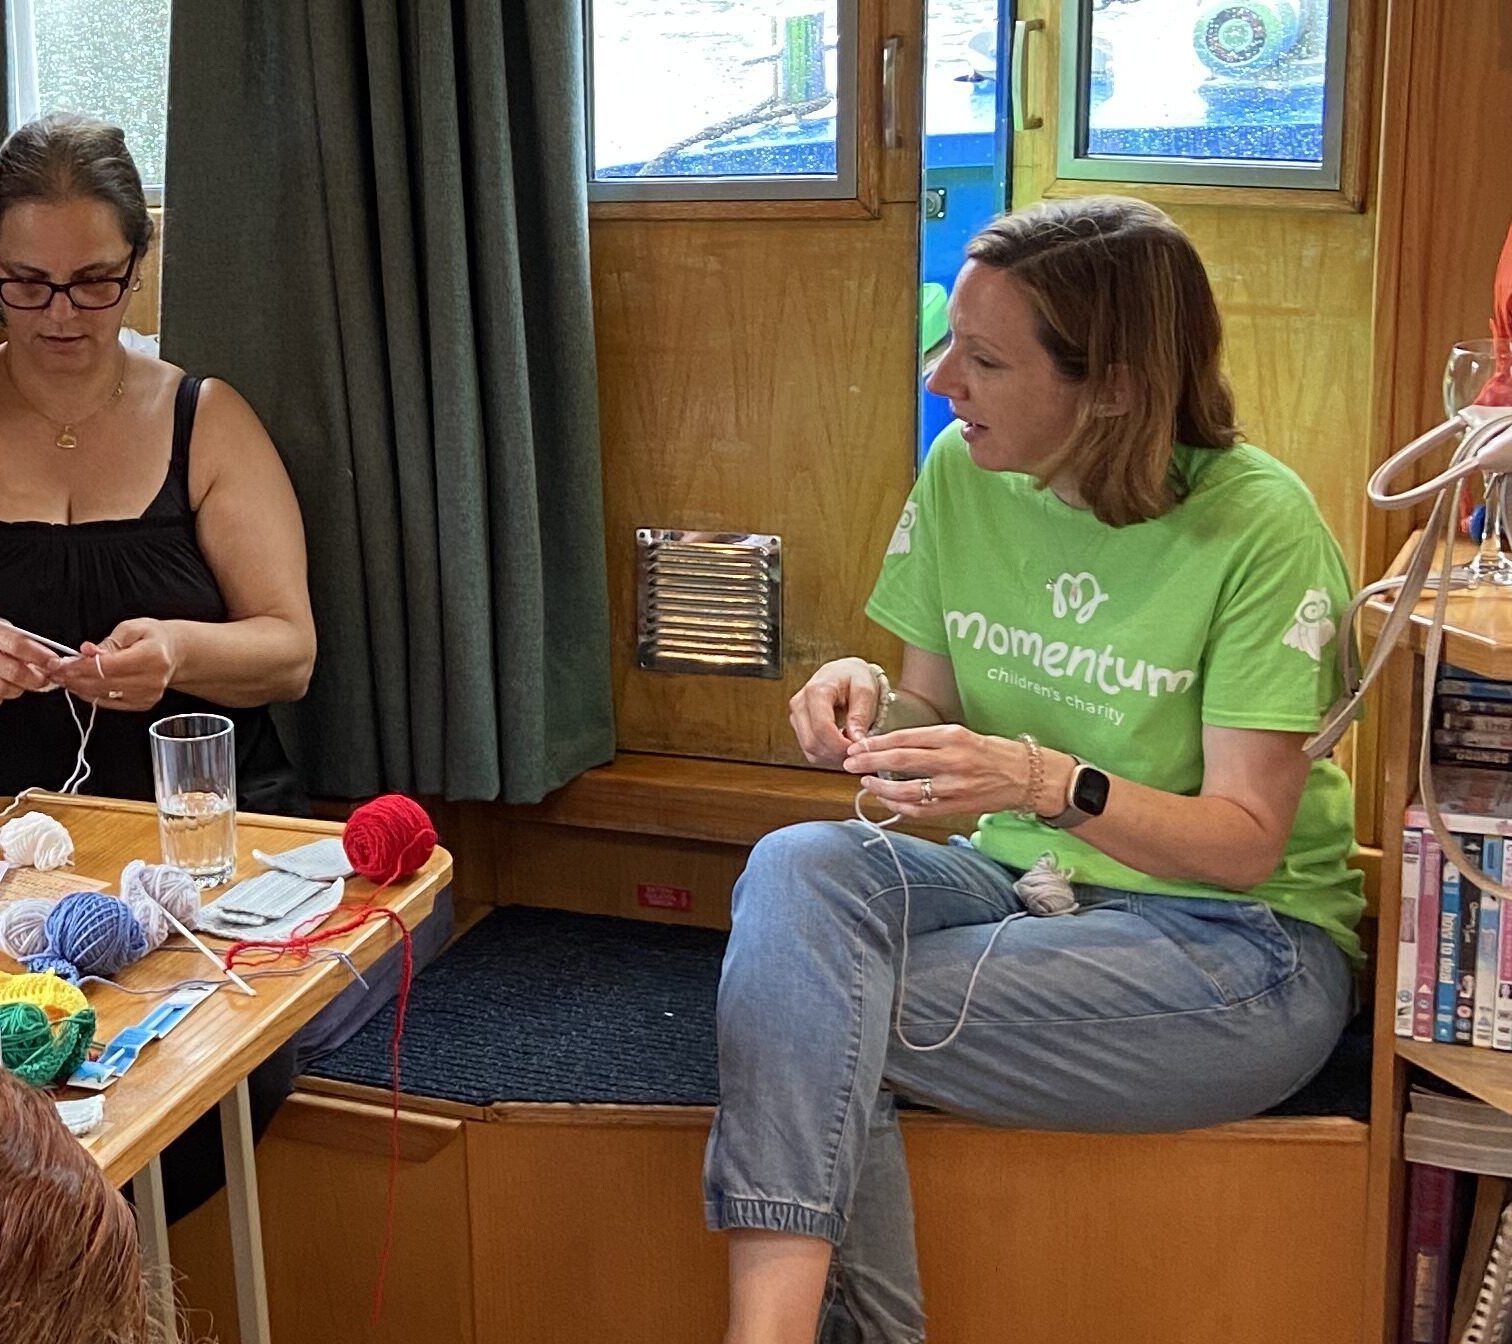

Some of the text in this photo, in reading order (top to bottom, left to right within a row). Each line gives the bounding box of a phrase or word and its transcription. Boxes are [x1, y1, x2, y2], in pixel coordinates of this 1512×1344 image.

[943, 610, 1194, 698] momentum
[987, 666, 1125, 726] children's charity
[1440, 911, 1458, 940] how
[1439, 942, 1455, 955] to
